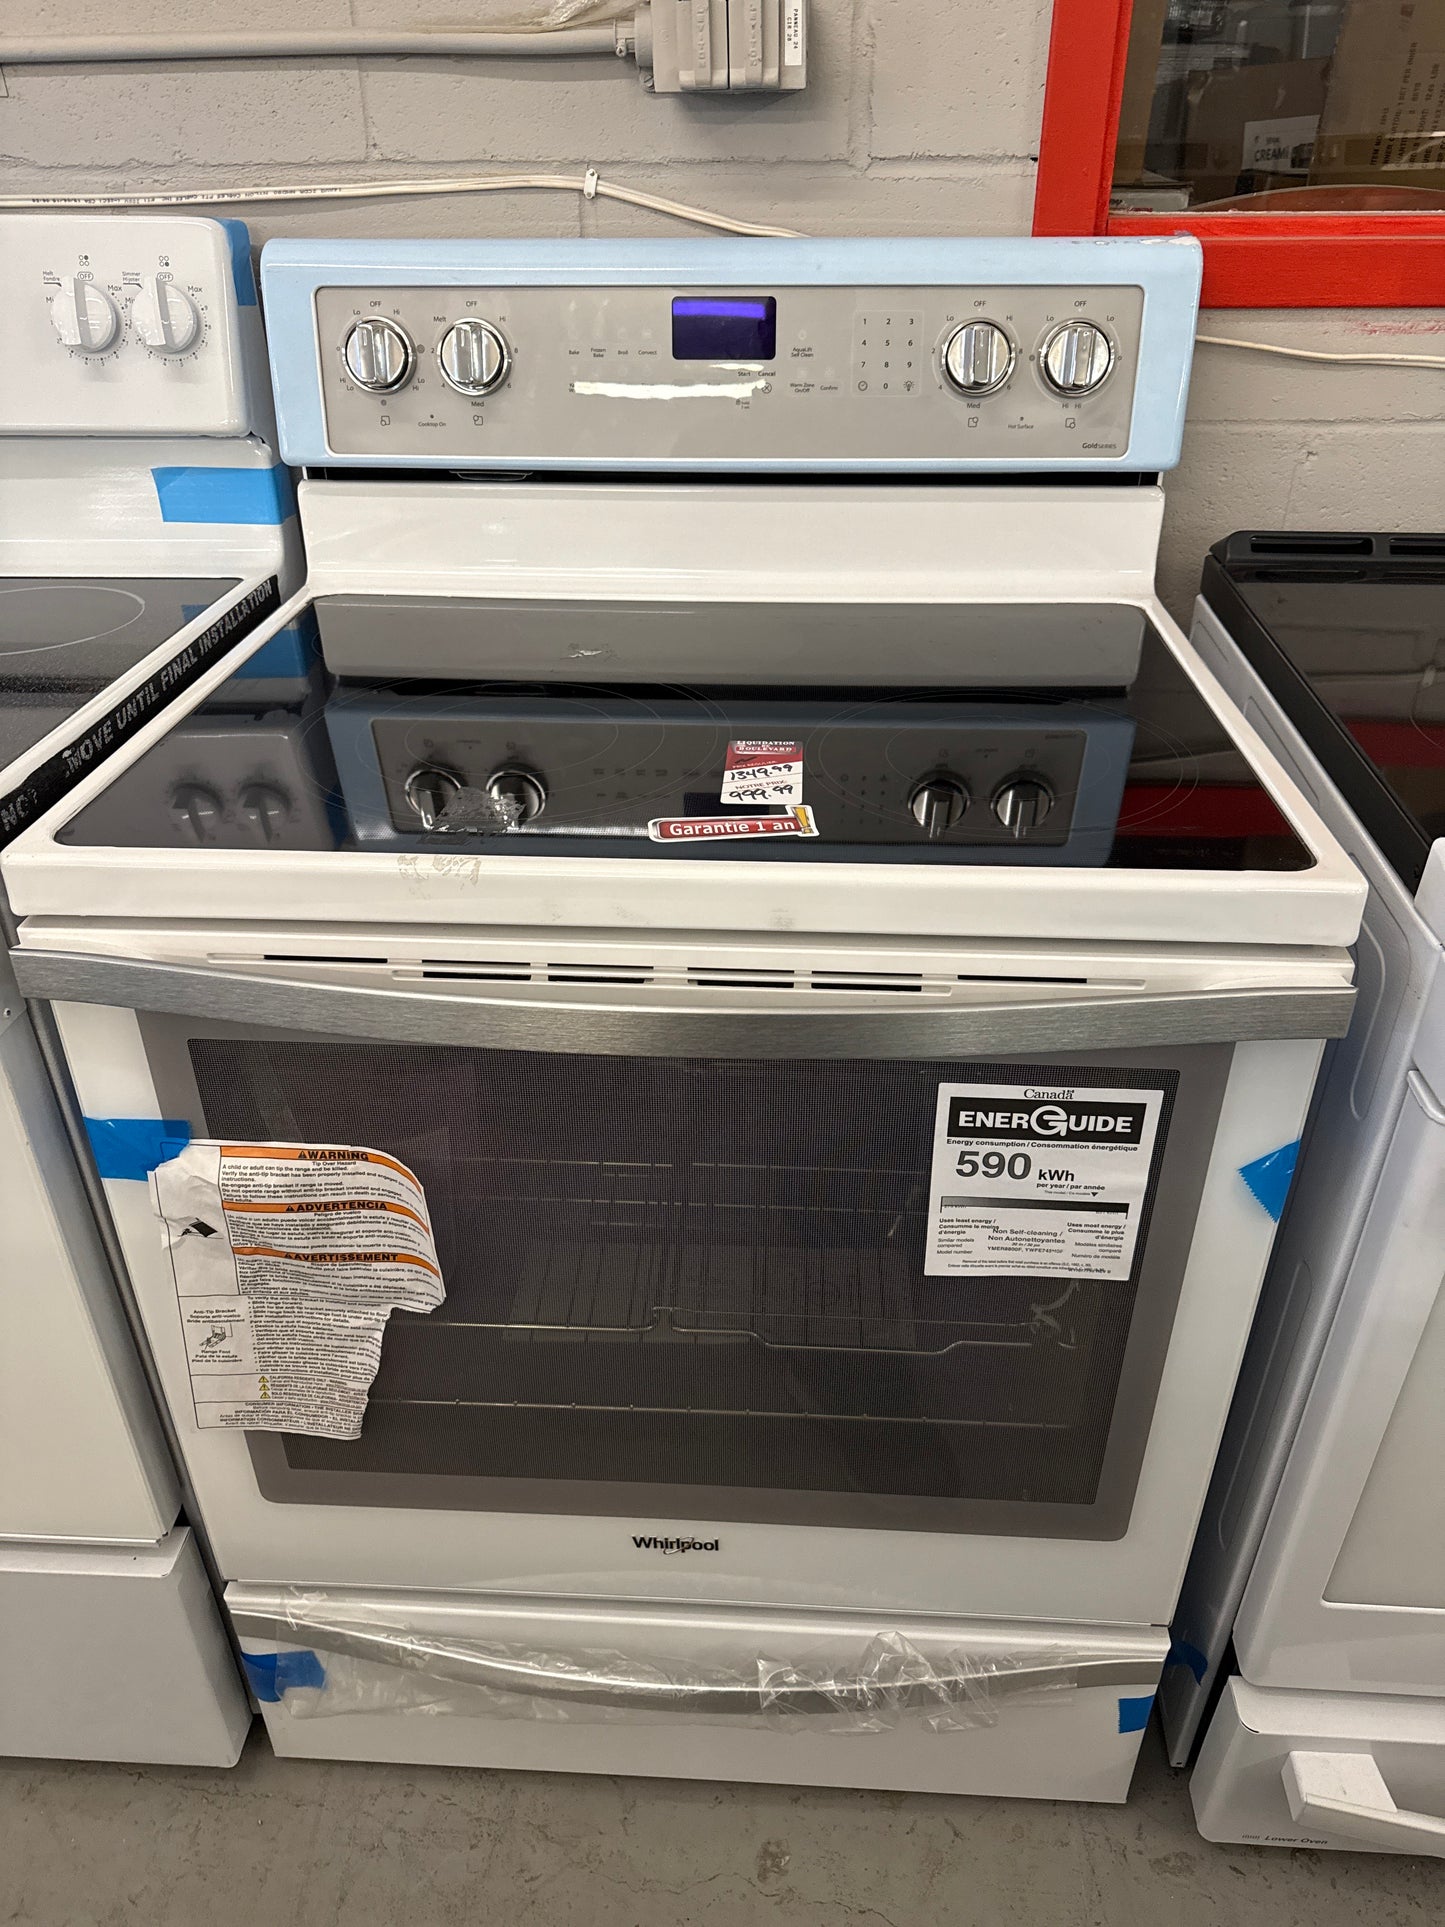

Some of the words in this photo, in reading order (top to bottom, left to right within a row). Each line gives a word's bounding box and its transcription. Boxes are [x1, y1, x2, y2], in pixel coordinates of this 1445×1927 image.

[793, 41, 798, 49] 24
[116, 683, 160, 730] UNTIL
[160, 648, 198, 692] FINAL
[199, 579, 273, 656] INSTALLATION
[730, 764, 792, 780] 1349.99
[729, 784, 794, 801] 999.99
[735, 782, 764, 790] NOTRE
[670, 821, 750, 836] Garantie
[756, 821, 766, 832] 1
[773, 821, 796, 830] an
[1024, 1088, 1075, 1100] Canada
[958, 1104, 1133, 1137] ENERGUIDE
[946, 1138, 974, 1148] Energy
[976, 1140, 1026, 1148] consumption
[1030, 1142, 1090, 1150] Consommation
[1091, 1142, 1138, 1152] énergétique
[308, 1150, 368, 1160] WARNING
[956, 1150, 1032, 1180] 590
[1038, 1169, 1074, 1182] kWh
[296, 1202, 388, 1212] ADVERTENCIA
[1004, 1236, 1066, 1244] Autonettoyantes
[1010, 1229, 1058, 1238] Self-cleaning
[294, 1253, 398, 1262] AVERTISSEMENT
[632, 1536, 719, 1554] Whirlpool
